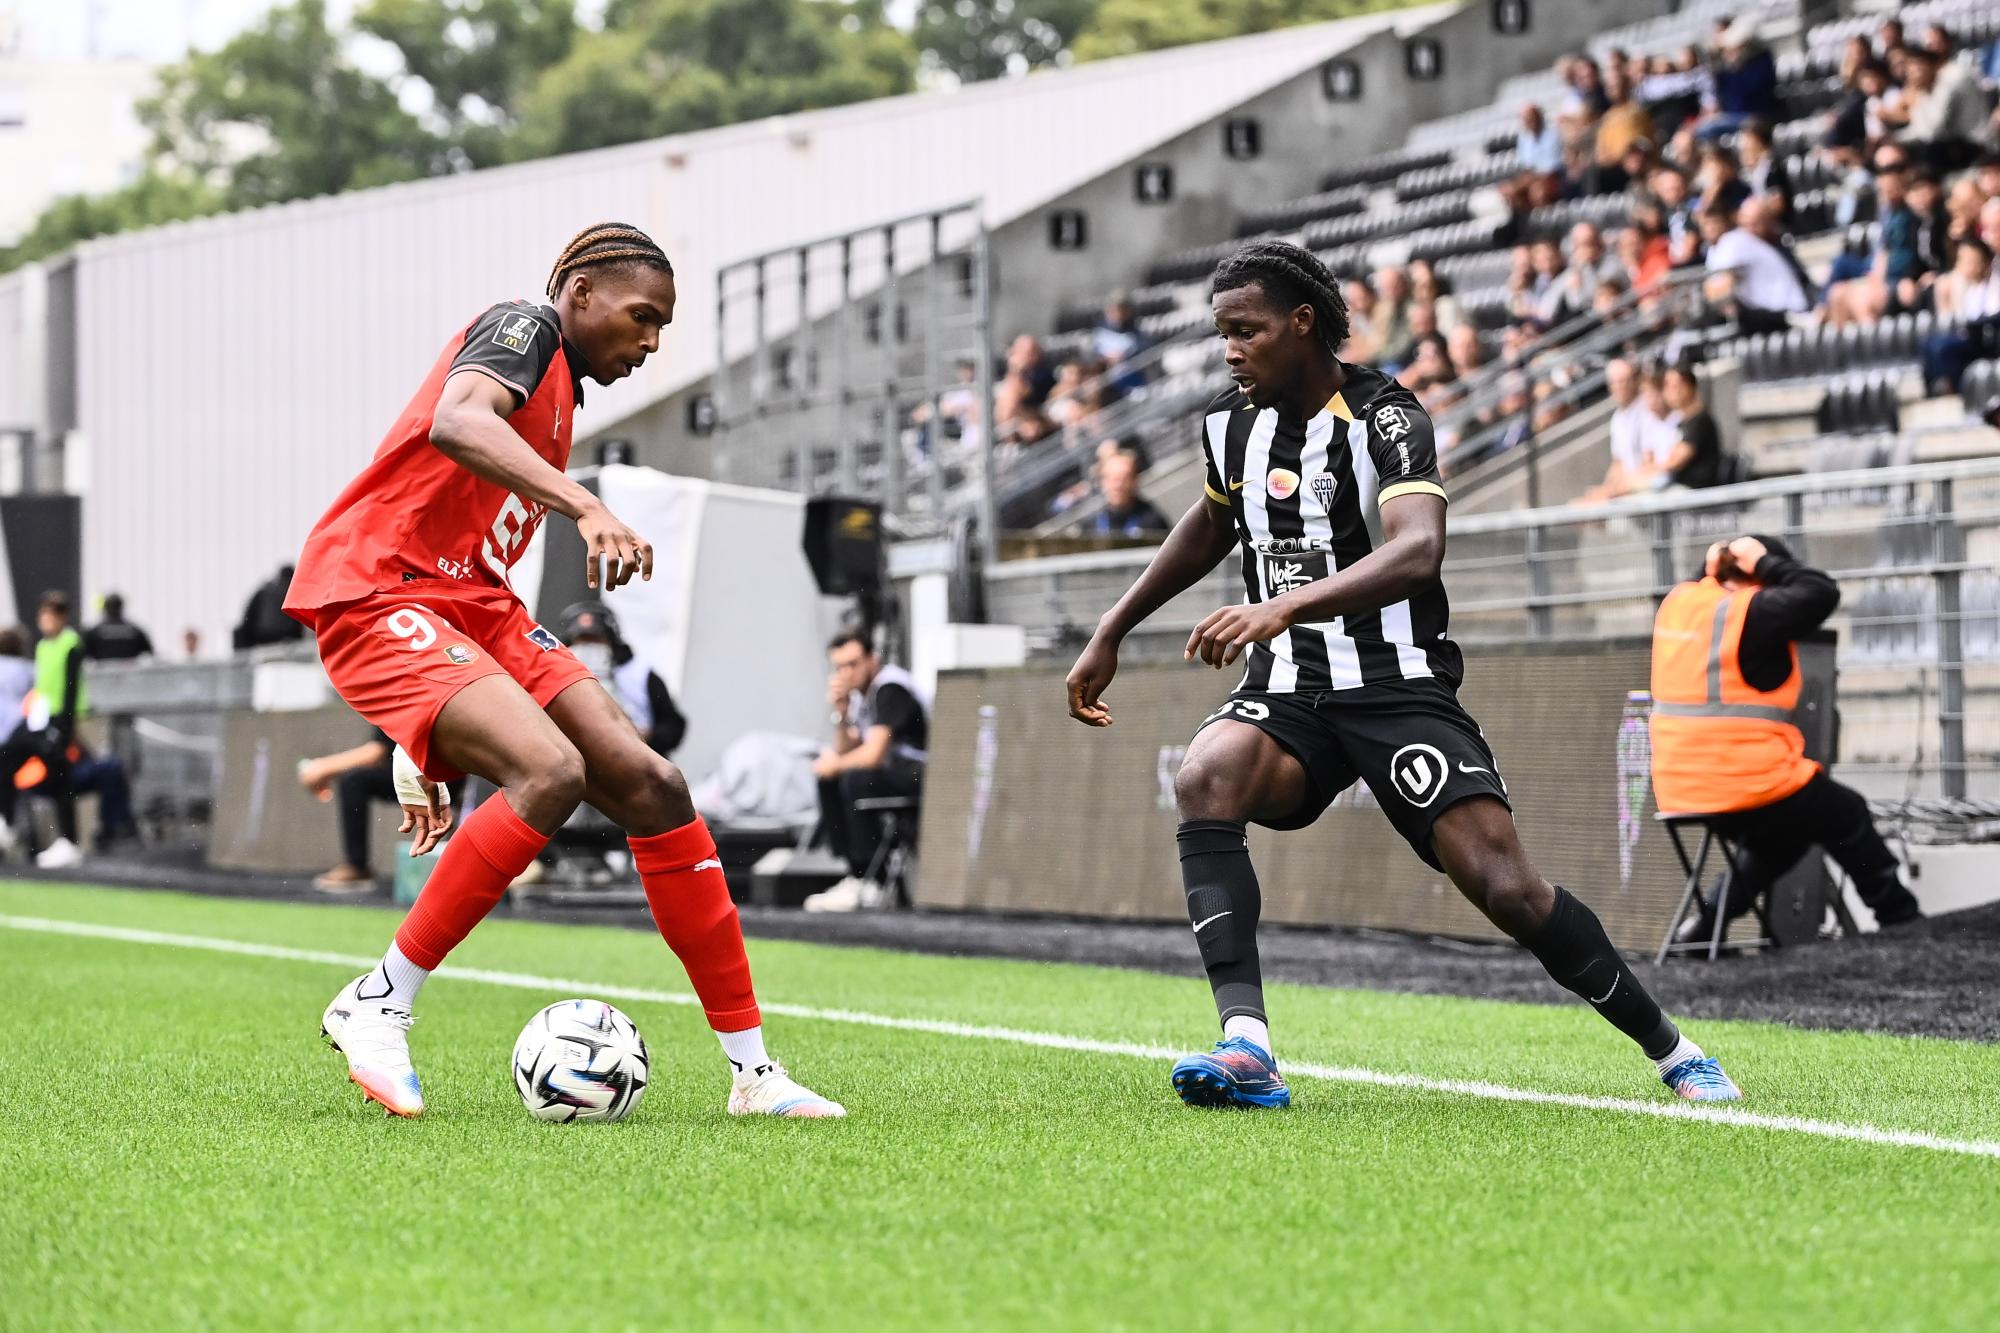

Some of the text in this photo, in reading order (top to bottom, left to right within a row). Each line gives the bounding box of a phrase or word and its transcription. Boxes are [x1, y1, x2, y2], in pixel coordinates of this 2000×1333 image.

[502, 326, 525, 340] LIGUE
[1375, 404, 1408, 441] BFK
[1313, 478, 1332, 491] SCO
[436, 556, 459, 579] ELA
[387, 608, 438, 650] 9
[1400, 754, 1432, 795] U
